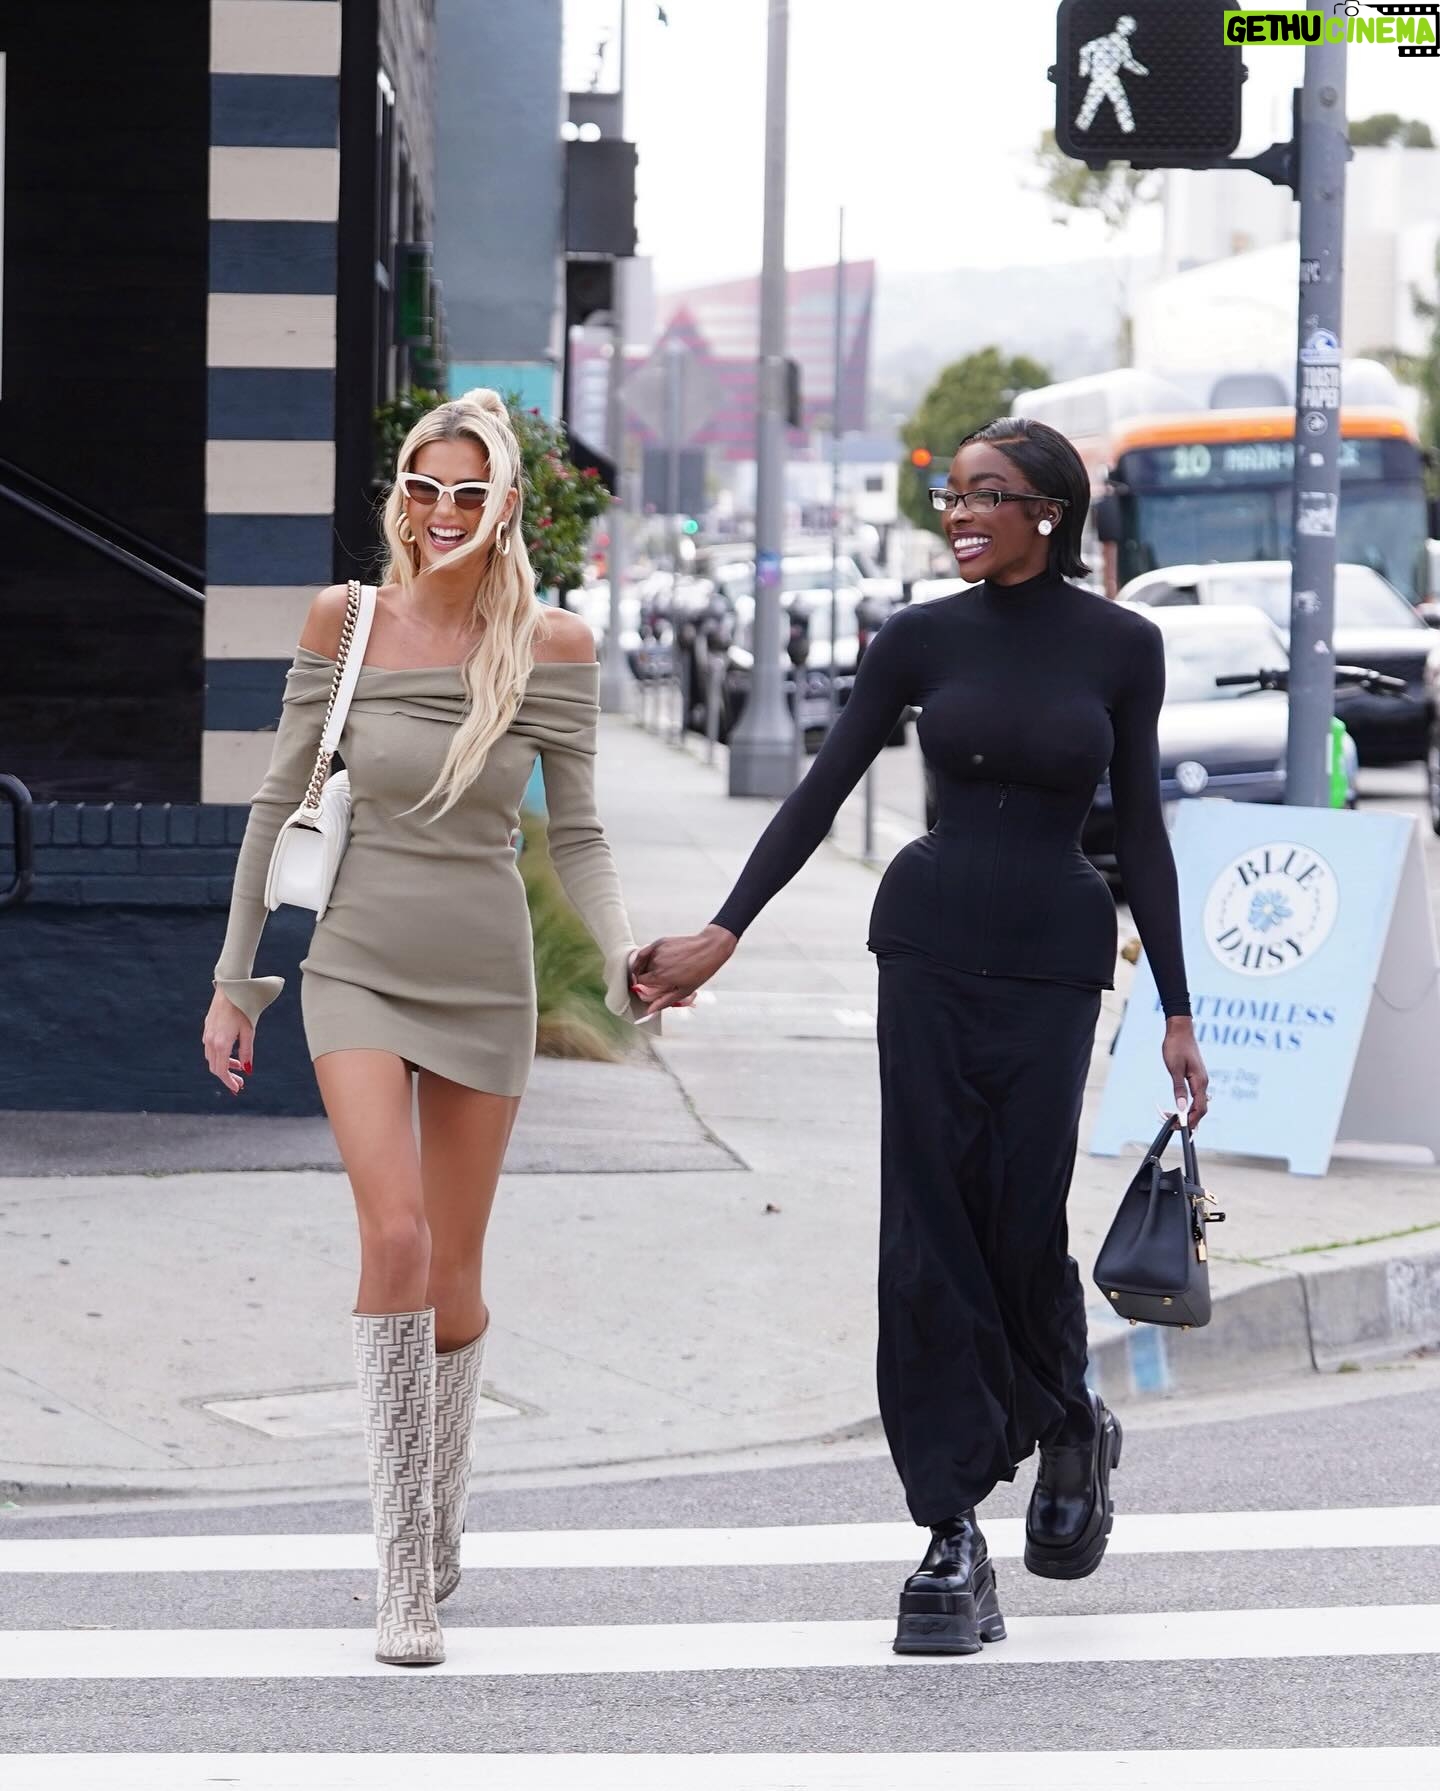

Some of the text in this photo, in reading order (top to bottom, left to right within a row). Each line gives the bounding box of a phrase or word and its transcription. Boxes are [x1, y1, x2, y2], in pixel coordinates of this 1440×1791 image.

[1172, 444, 1212, 479] 10
[1236, 848, 1324, 891] BLUE
[1216, 927, 1303, 969] DAISY
[1154, 993, 1337, 1025] TTOMLESS
[1194, 1022, 1303, 1051] IMOSAS
